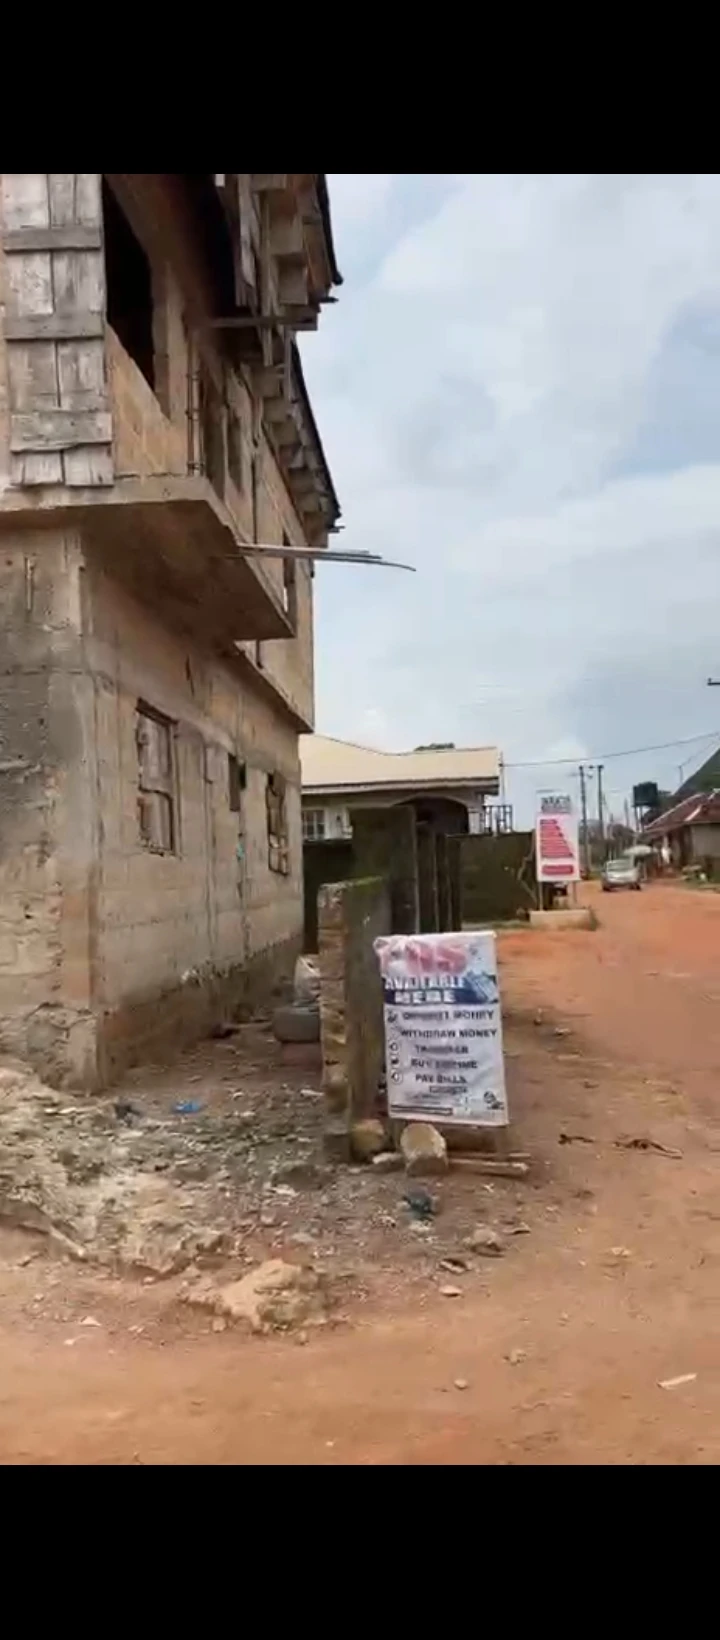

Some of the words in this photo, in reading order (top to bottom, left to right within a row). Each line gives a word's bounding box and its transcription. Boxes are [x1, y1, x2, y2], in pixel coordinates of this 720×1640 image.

[381, 940, 467, 976] OS
[395, 990, 457, 1004] HERE
[400, 1028, 456, 1039] WITHDRAW
[459, 1028, 498, 1038] MONEY
[414, 1044, 470, 1054] TRER
[435, 1059, 479, 1069] TIME
[416, 1073, 434, 1084] PAY
